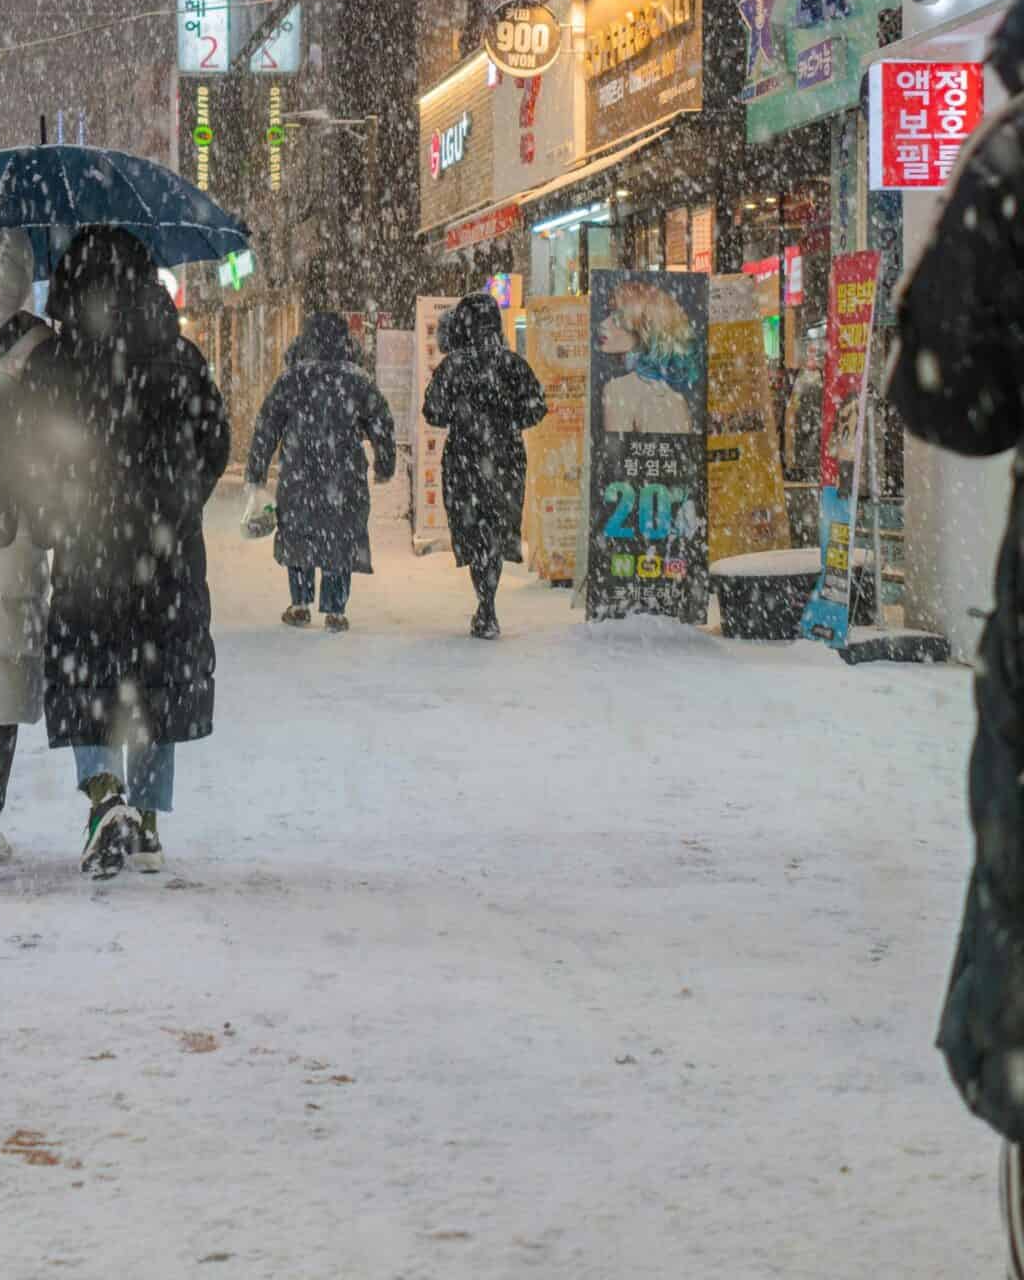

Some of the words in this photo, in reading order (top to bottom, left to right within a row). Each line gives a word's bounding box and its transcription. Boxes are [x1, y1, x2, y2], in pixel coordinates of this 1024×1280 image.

[200, 35, 219, 68] 2
[495, 22, 550, 55] 900
[507, 55, 536, 68] WON
[896, 69, 968, 108] 액정
[896, 108, 968, 140] 보호
